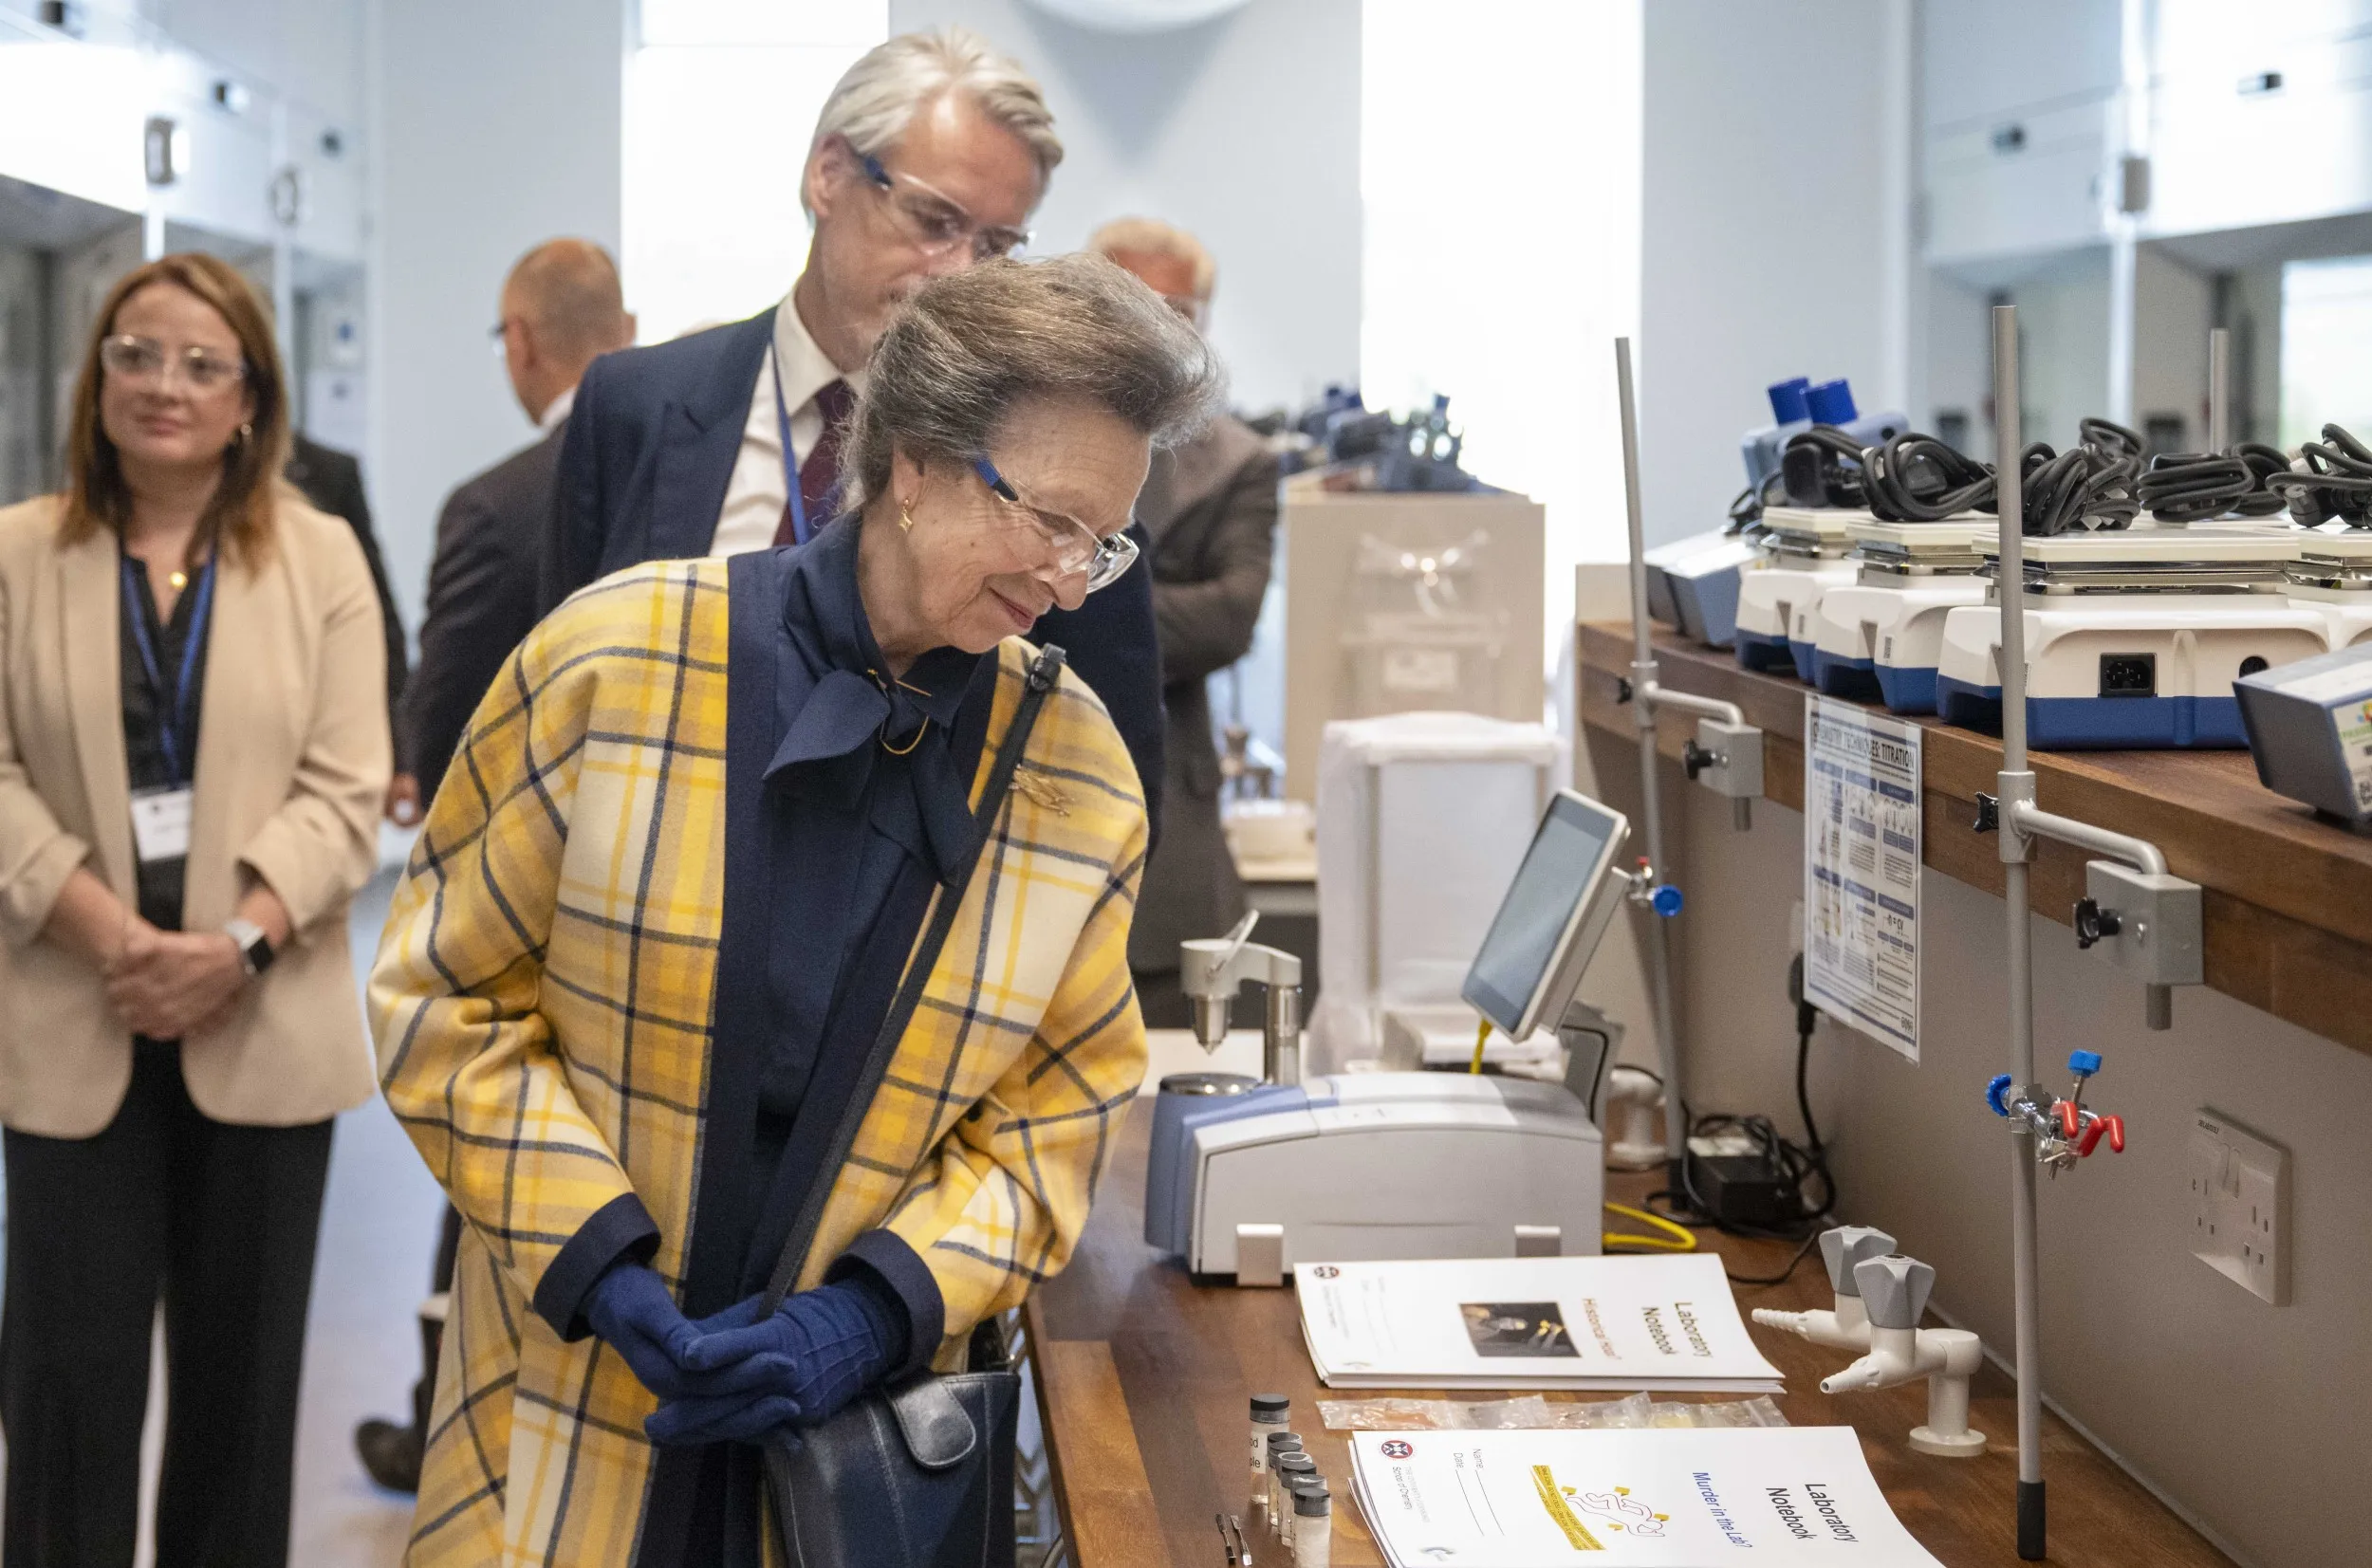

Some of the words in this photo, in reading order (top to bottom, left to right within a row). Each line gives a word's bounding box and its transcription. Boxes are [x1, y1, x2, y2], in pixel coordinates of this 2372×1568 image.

[1881, 743, 1915, 770] TITRATION
[1641, 1306, 1679, 1355] Notebook
[1675, 1301, 1714, 1357] Laboratory
[1454, 1452, 1464, 1469] Date
[1692, 1472, 1719, 1507] Murder
[1710, 1508, 1727, 1517] in
[1716, 1518, 1735, 1532] the
[1766, 1487, 1818, 1540] Notebook
[1805, 1484, 1860, 1541] Laboratory
[1726, 1532, 1753, 1548] Lab?
